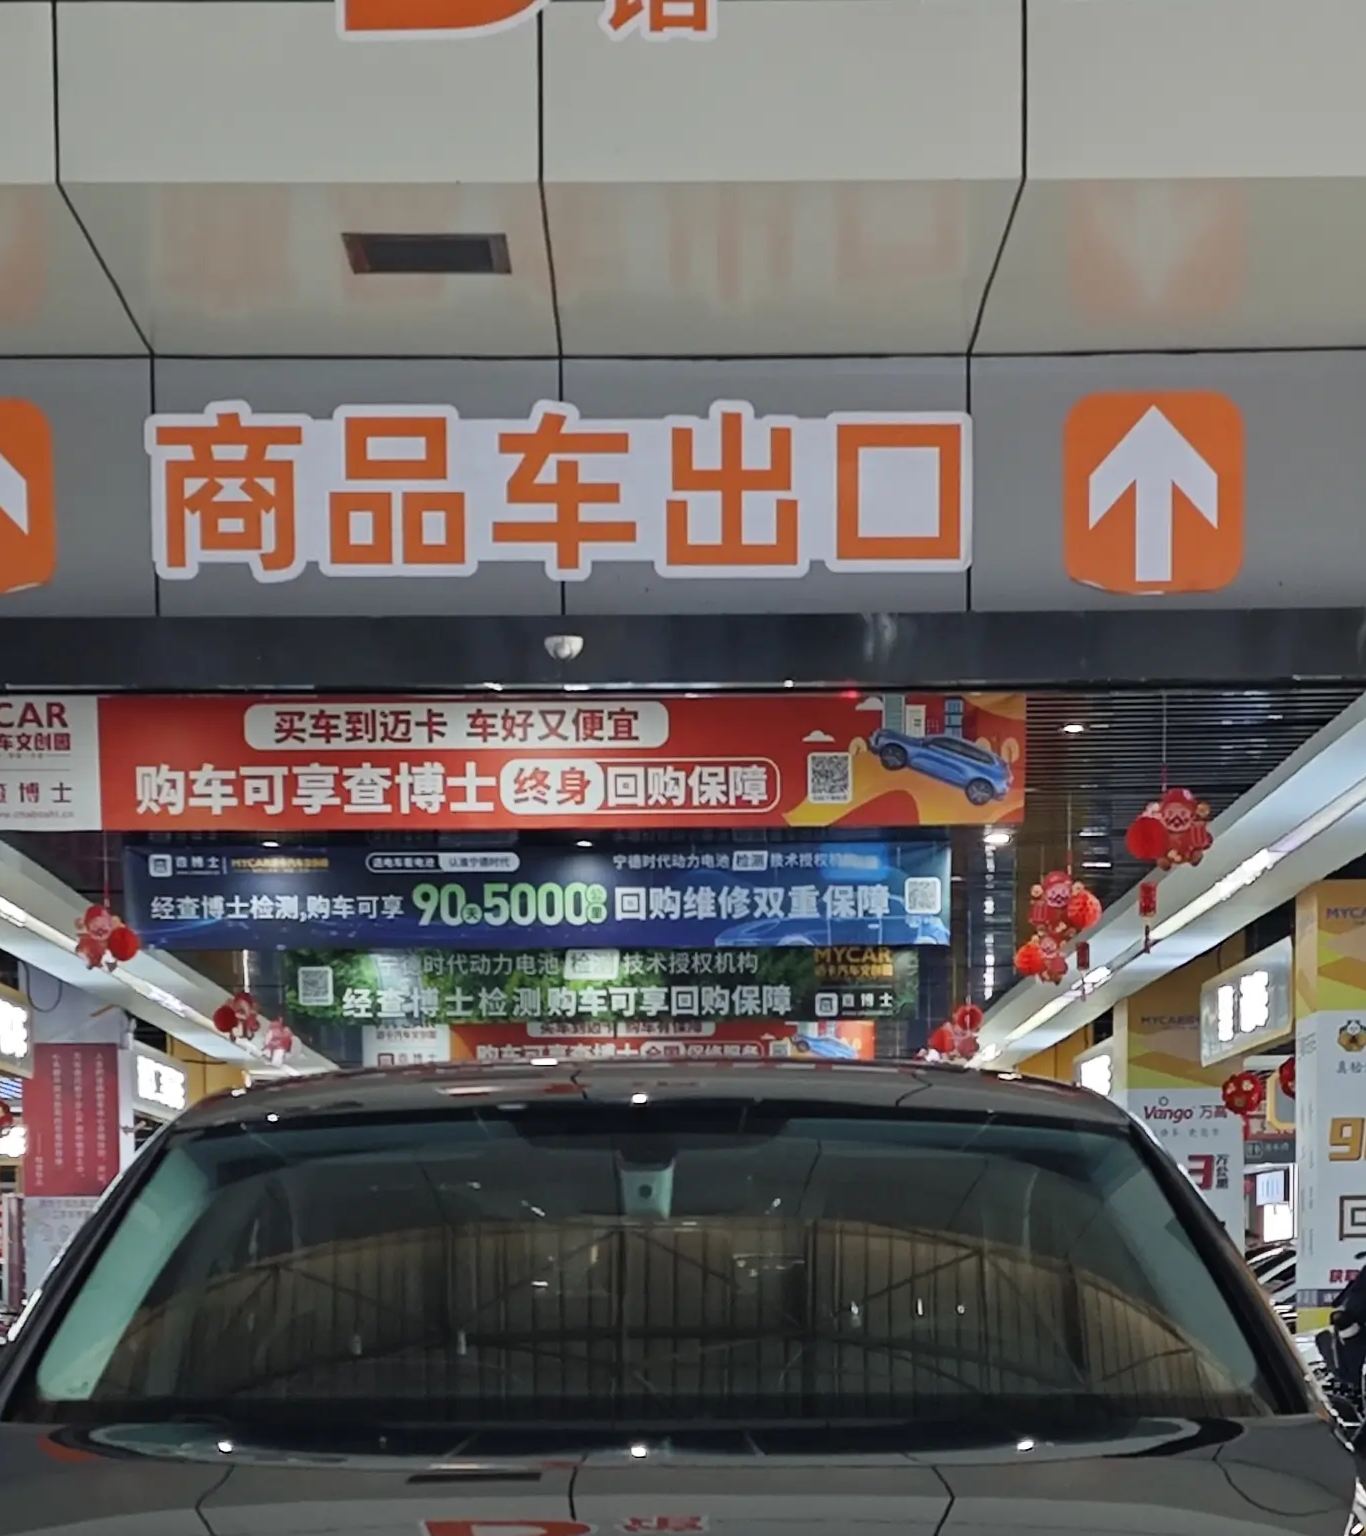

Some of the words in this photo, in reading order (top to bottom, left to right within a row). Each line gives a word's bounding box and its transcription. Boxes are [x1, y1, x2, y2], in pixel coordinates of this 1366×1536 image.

[162, 412, 962, 572] 商品车出口
[275, 709, 448, 744] 买车到迈卡
[466, 707, 641, 742] 车好又便宜
[135, 761, 770, 816] 购车可享查博士终身回购保障
[615, 885, 890, 921] 回购维修双重保障
[342, 985, 792, 1019] 经查博士检测购车可享回购保障
[1143, 1105, 1194, 1124] Vango
